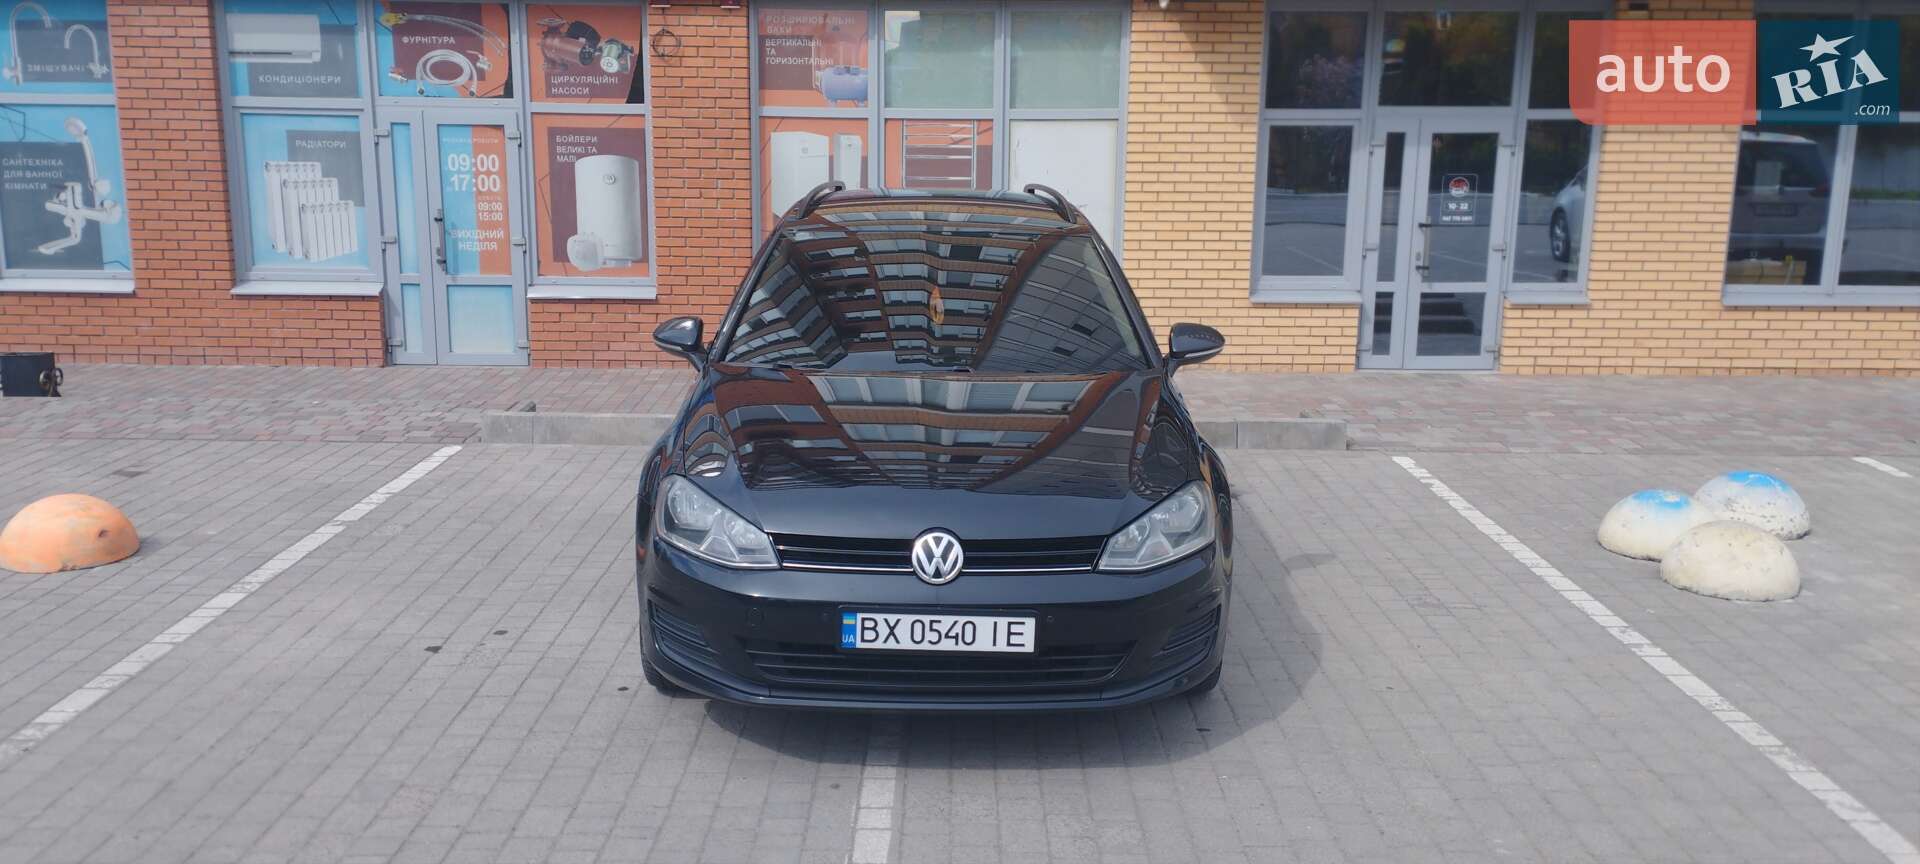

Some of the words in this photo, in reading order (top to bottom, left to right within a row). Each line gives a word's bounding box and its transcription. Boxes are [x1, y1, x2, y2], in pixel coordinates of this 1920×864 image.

[402, 36, 456, 45] ФУРНІТУРА
[766, 48, 776, 56] ТА
[765, 56, 834, 65] ГОРИЗОНТАЛЬНІ
[551, 75, 619, 86] ЦИРКУЛЯЦІЙНІ
[551, 87, 590, 95] НАСОСИ
[556, 134, 598, 143] БОЙЛЕРИ
[295, 139, 346, 149] РАДІАТОРИ
[556, 145, 586, 153] ВЕЛИКІ
[587, 146, 598, 154] ТА
[2, 157, 64, 167] САНТЕХНІКА
[447, 153, 499, 172] 09:00
[449, 174, 500, 192] 17:00
[478, 202, 503, 211] 09:00
[478, 212, 503, 221] 15:00
[450, 227, 504, 240] ВИХІДНИЙ
[458, 241, 498, 252] НЕДІЛЯ
[860, 617, 901, 644] BX
[910, 619, 977, 646] 0540
[992, 621, 1026, 647] IE
[842, 634, 855, 643] UA
